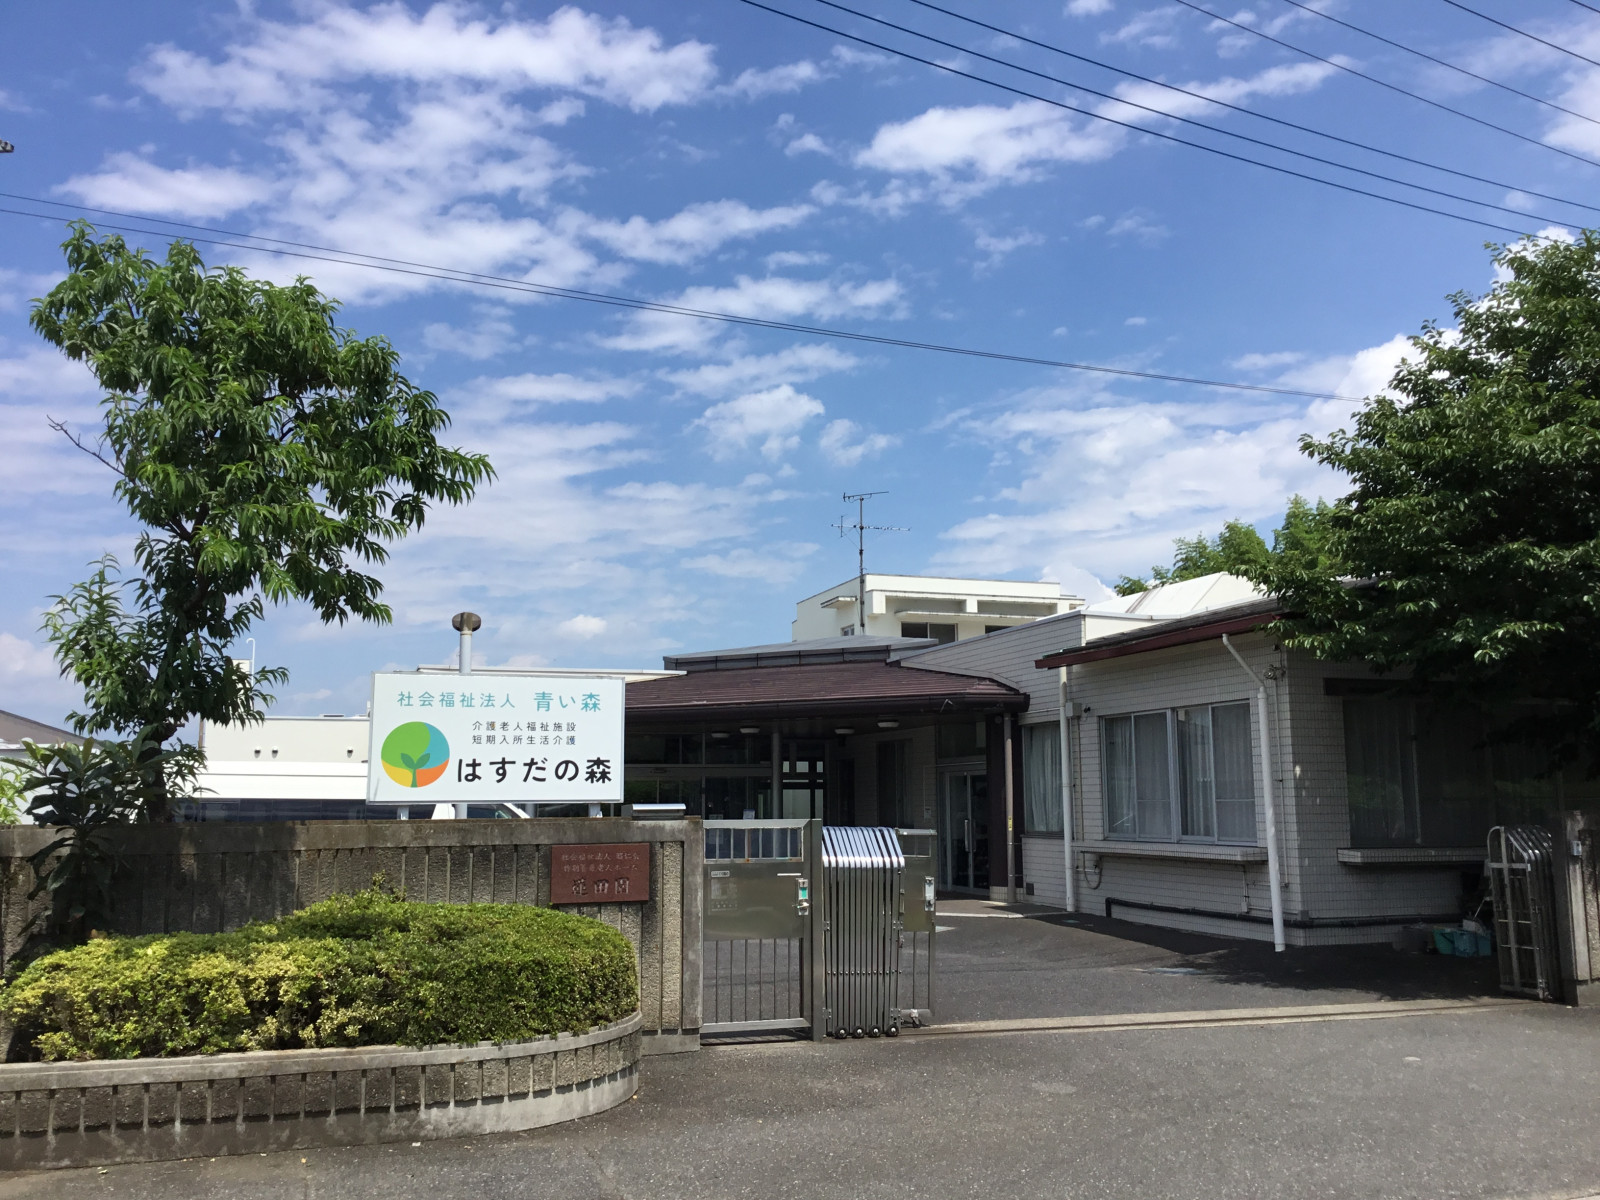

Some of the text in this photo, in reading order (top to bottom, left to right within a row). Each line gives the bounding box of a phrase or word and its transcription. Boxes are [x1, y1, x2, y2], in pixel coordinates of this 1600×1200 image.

[397, 691, 601, 712] 社会福祉法人 青い森
[472, 720, 576, 732] 介護老人福祉施設
[472, 734, 576, 746] 短期入所生活介護
[457, 757, 612, 784] はすだの森
